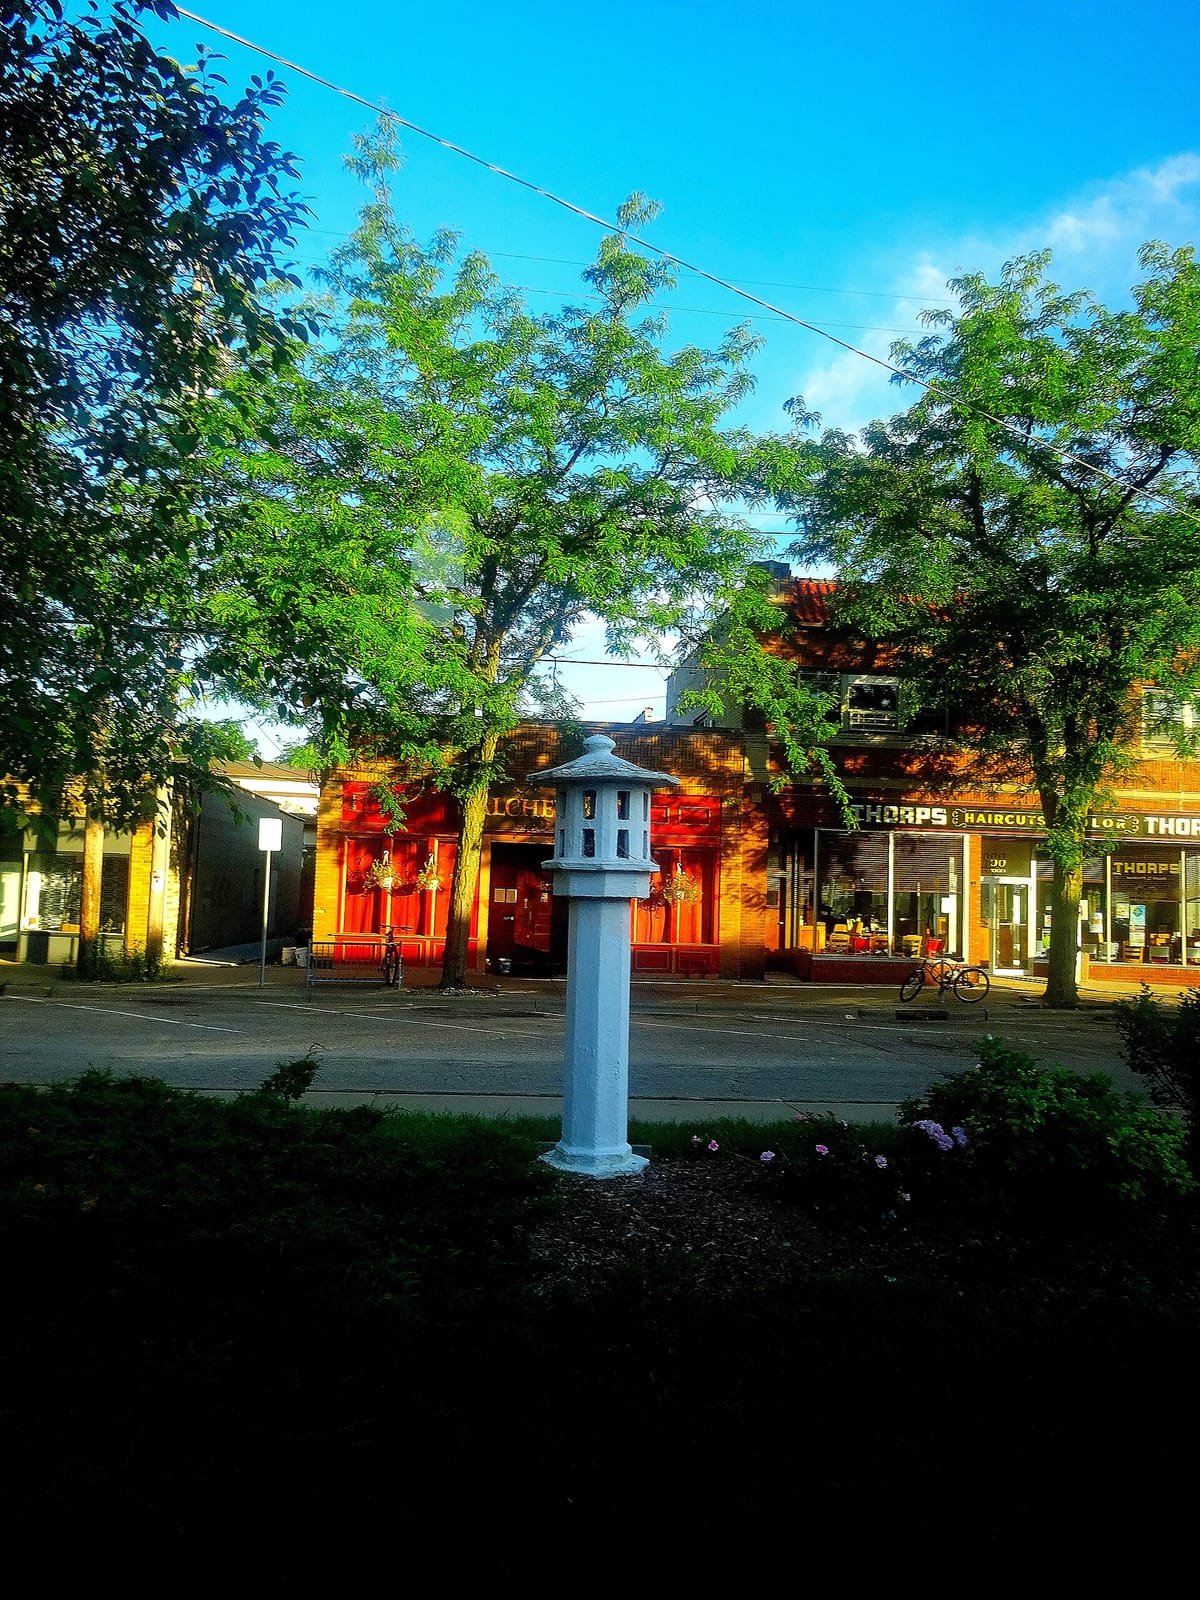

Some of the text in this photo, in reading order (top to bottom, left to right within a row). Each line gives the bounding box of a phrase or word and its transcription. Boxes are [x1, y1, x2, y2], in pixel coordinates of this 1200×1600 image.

[850, 804, 948, 826] THORPS
[964, 812, 1047, 826] HAIRCUTS
[1113, 862, 1179, 875] THORPS
